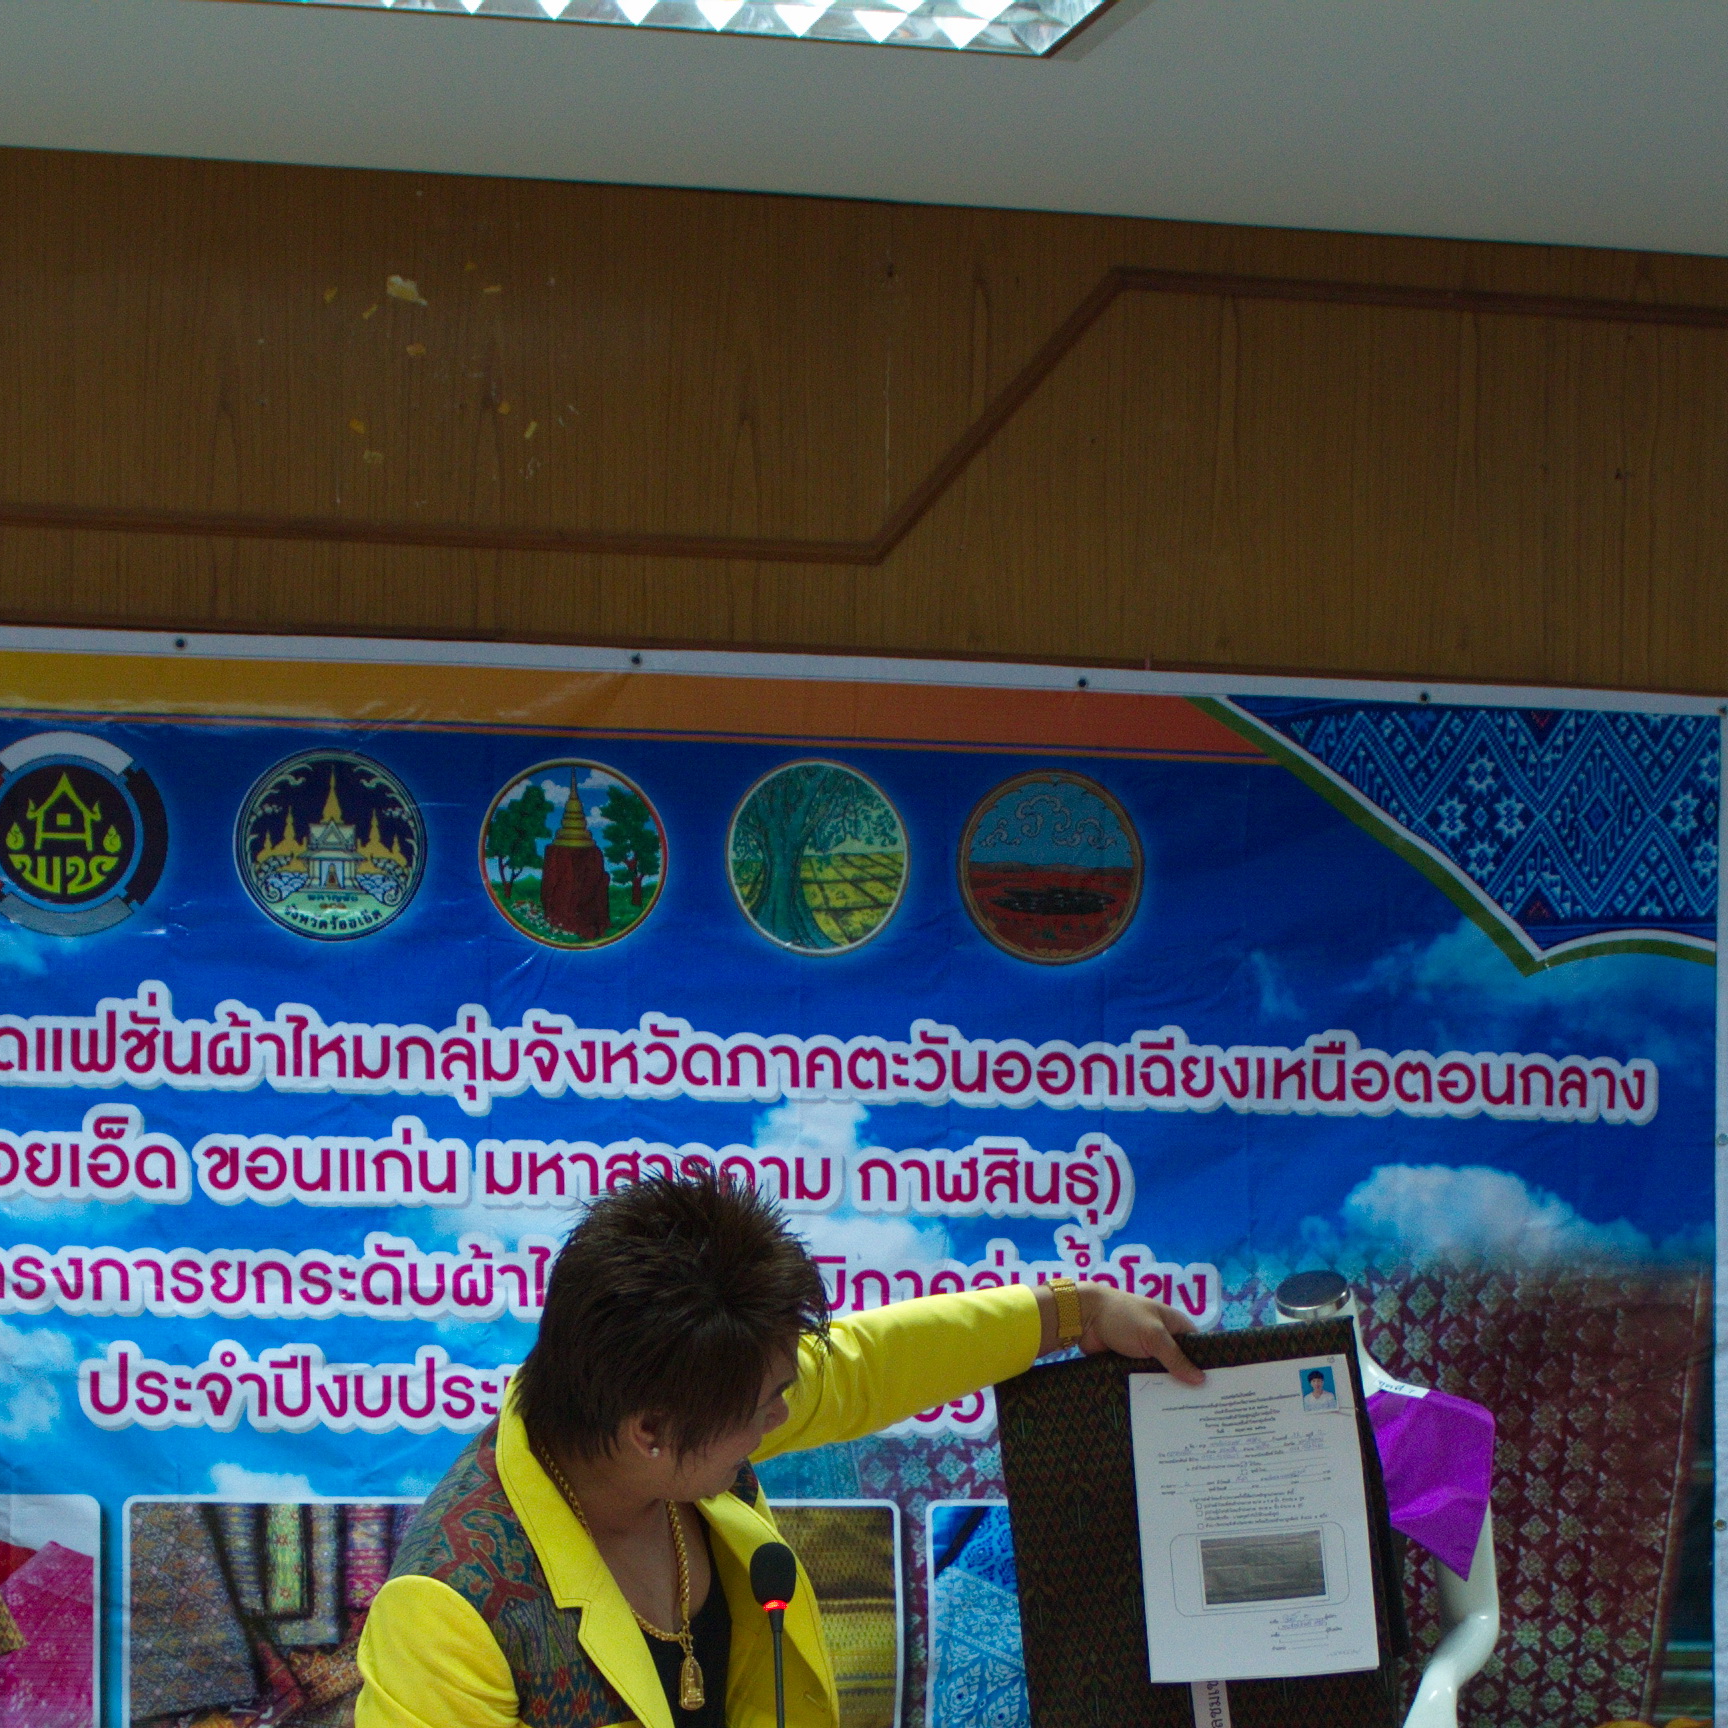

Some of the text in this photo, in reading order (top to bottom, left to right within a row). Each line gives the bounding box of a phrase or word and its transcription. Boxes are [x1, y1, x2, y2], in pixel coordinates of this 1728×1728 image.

[202, 1126, 457, 1193] ขอนแก่น
[857, 1145, 1123, 1225] กาฬสินธุ์)
[89, 1351, 512, 1420] ประจำปีงบประ
